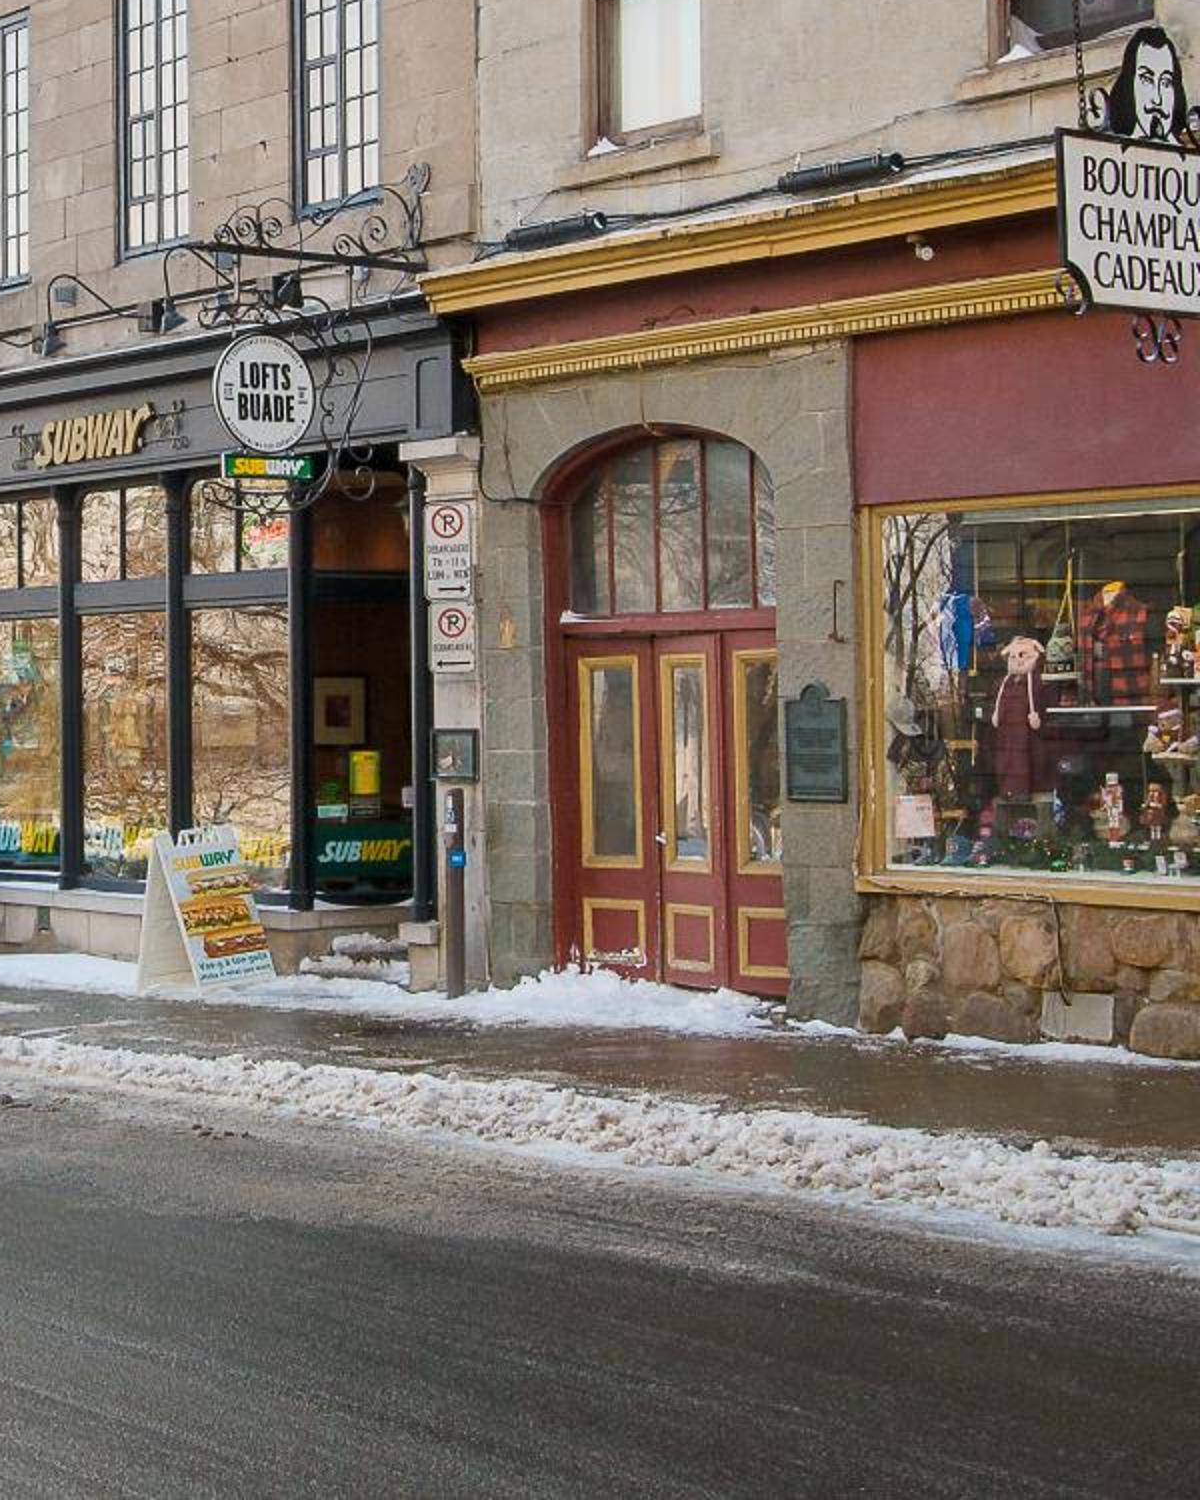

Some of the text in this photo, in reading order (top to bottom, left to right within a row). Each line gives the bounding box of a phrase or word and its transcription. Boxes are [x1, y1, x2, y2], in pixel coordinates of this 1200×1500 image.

[1094, 252, 1200, 297] CADEAU
[239, 361, 291, 390] LOFTS
[237, 393, 295, 423] BUADE
[34, 402, 153, 469] SUBWAY
[234, 457, 305, 476] SUBWAY
[175, 849, 234, 869] SUBWAY
[317, 839, 411, 863] SUBWAY
